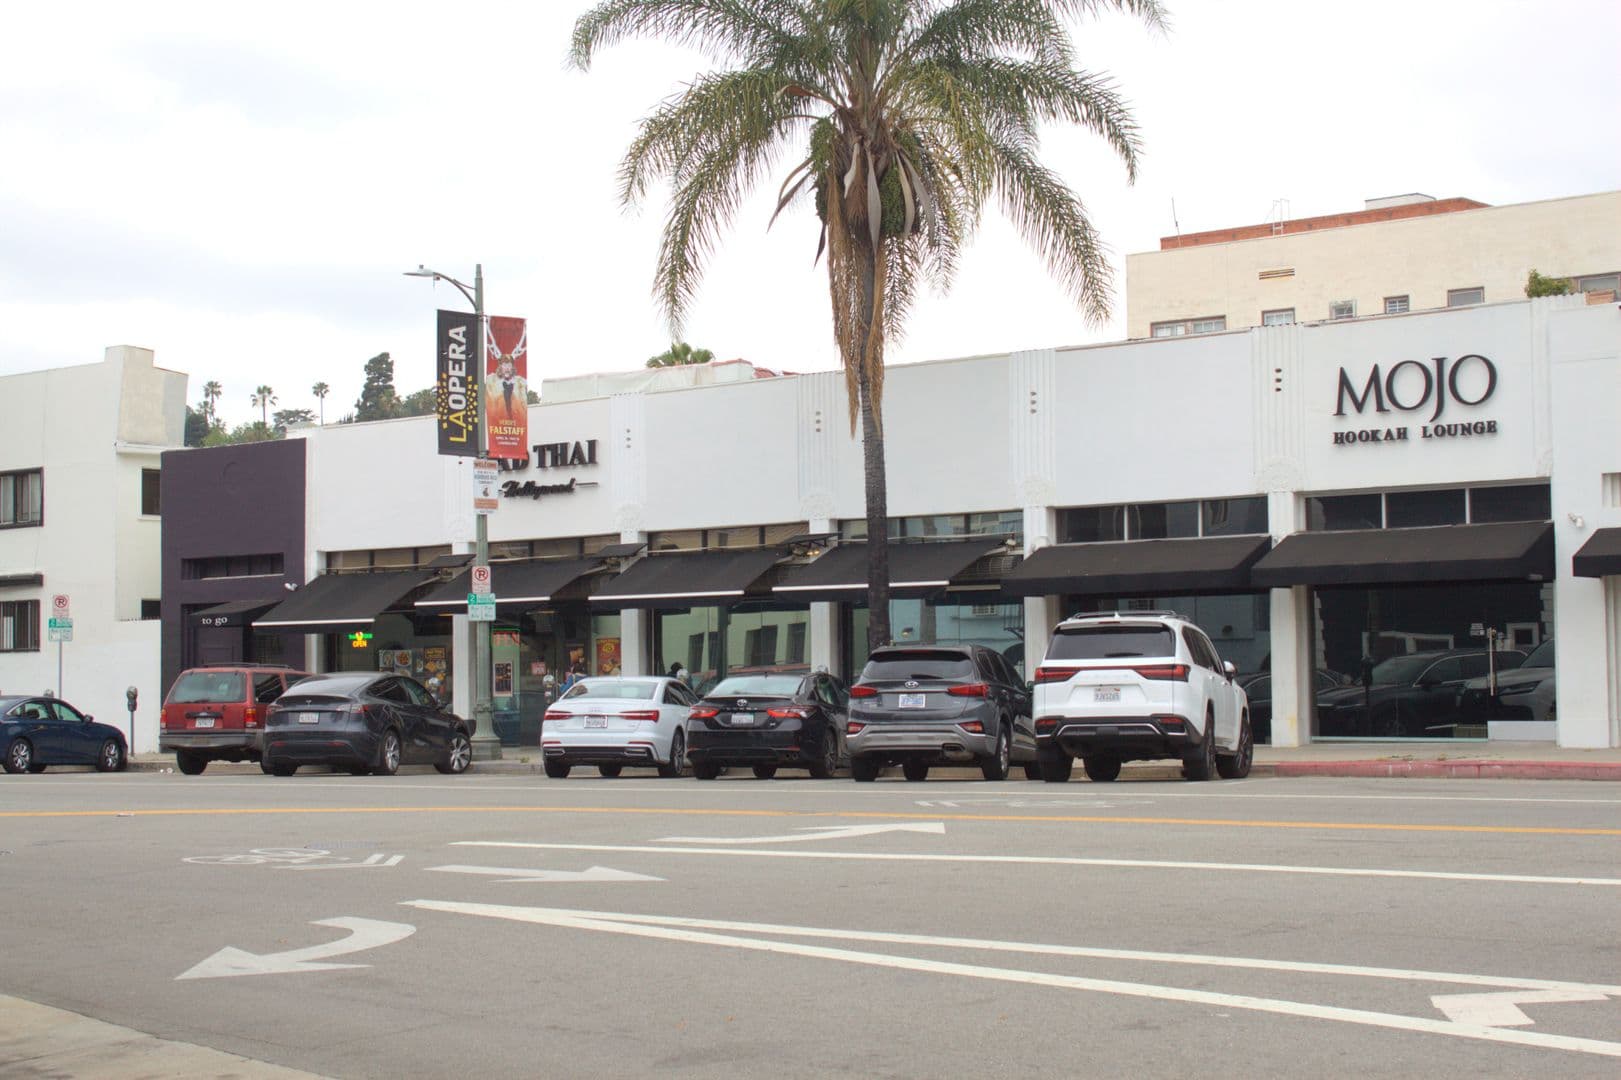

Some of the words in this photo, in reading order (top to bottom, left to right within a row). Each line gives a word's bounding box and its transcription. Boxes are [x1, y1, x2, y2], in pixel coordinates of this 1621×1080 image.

[1333, 354, 1497, 422] MOJO
[489, 425, 525, 436] FALSTAFF
[1333, 426, 1408, 445] HOOKAH
[1421, 420, 1498, 439] LOUNGE
[533, 439, 598, 469] THAI
[201, 617, 212, 625] to
[214, 616, 228, 627] go
[352, 640, 368, 649] OPEN
